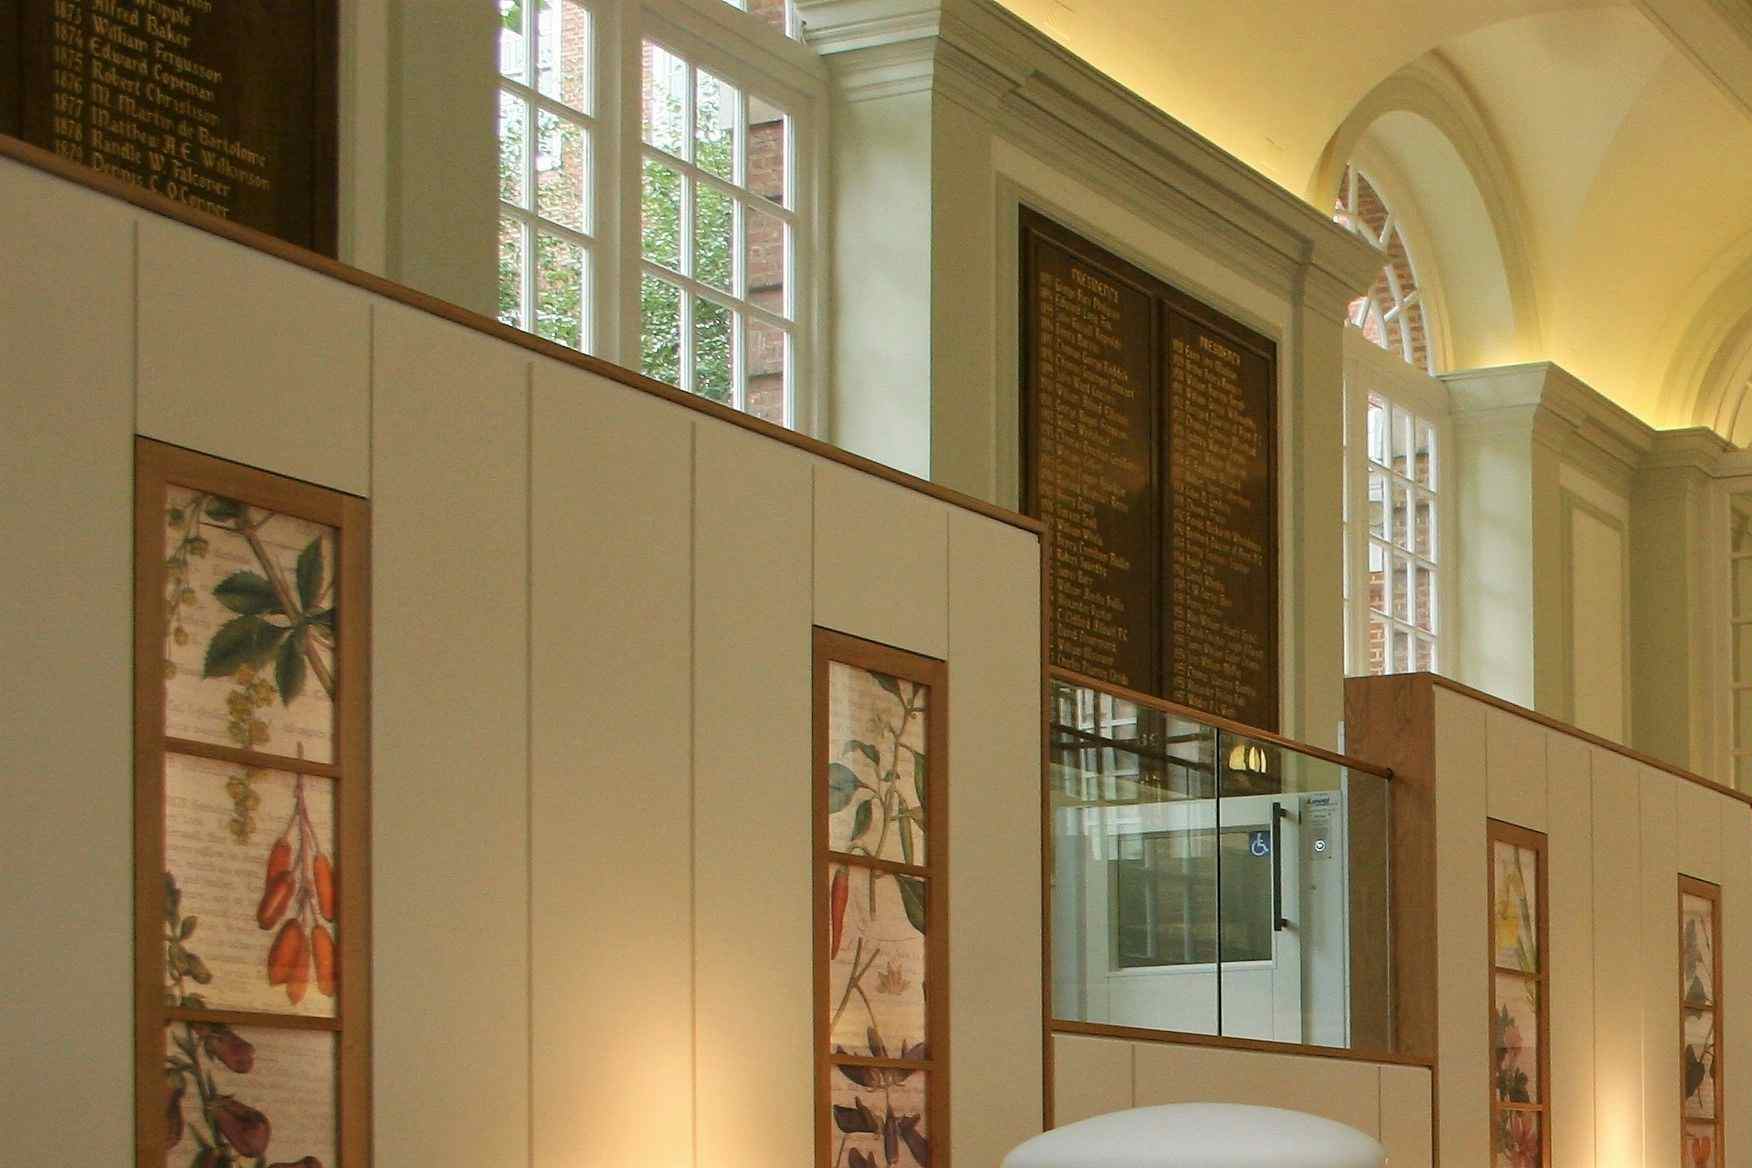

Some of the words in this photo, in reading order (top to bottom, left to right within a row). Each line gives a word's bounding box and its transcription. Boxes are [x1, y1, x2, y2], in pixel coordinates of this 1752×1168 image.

[54, 21, 83, 49] 1874
[89, 37, 148, 76] Edward
[92, 13, 147, 54] William
[146, 12, 192, 49] Baker
[91, 57, 140, 96] Robert
